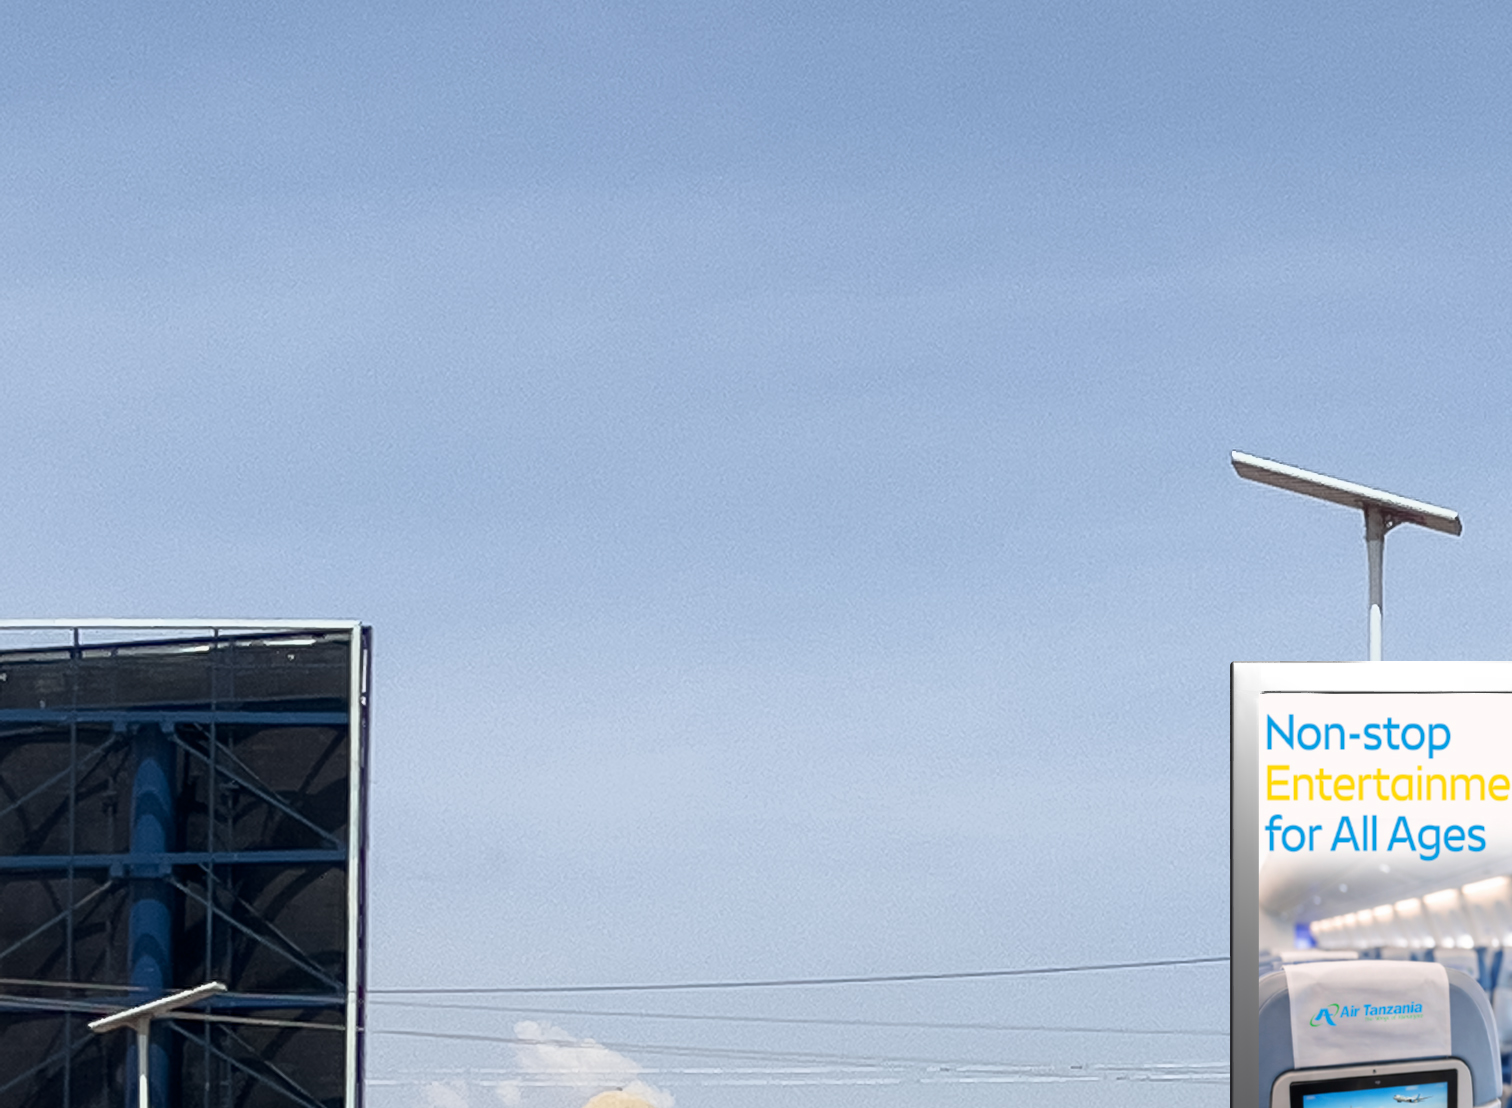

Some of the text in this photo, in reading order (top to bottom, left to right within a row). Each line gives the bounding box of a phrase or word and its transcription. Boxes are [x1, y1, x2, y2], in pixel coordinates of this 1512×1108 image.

[1266, 713, 1451, 759] Non-stop
[1264, 814, 1487, 862] for All Ages
[1339, 1001, 1423, 1018] Air Tanzania
